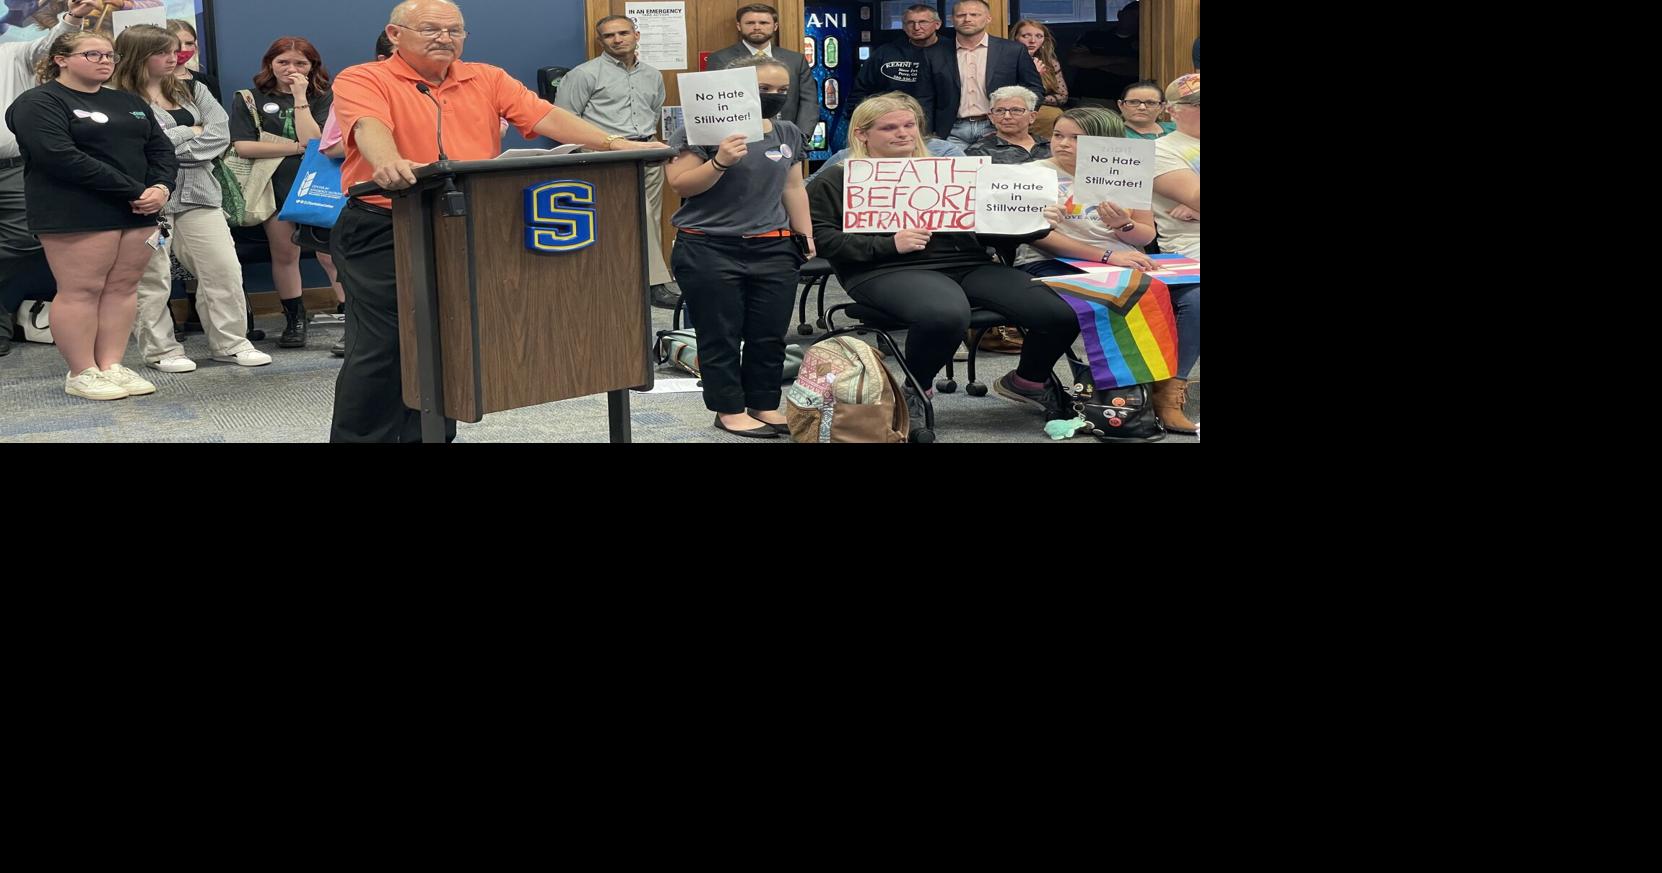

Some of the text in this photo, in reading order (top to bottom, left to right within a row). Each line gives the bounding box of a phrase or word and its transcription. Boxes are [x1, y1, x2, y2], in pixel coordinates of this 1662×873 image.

[806, 12, 847, 28] ANI
[695, 90, 744, 101] No Hate
[717, 103, 729, 111] in
[694, 112, 751, 124] Stillwater!
[1090, 155, 1141, 166] No Hate
[847, 158, 983, 184] DEATH
[1109, 167, 1119, 175] in
[991, 182, 1044, 191] No Hate
[1085, 176, 1142, 188] Stillwater!
[846, 185, 977, 211] BEFORE
[1010, 192, 1022, 201] in
[523, 179, 598, 252] S
[844, 209, 976, 230] DETRANSITIO
